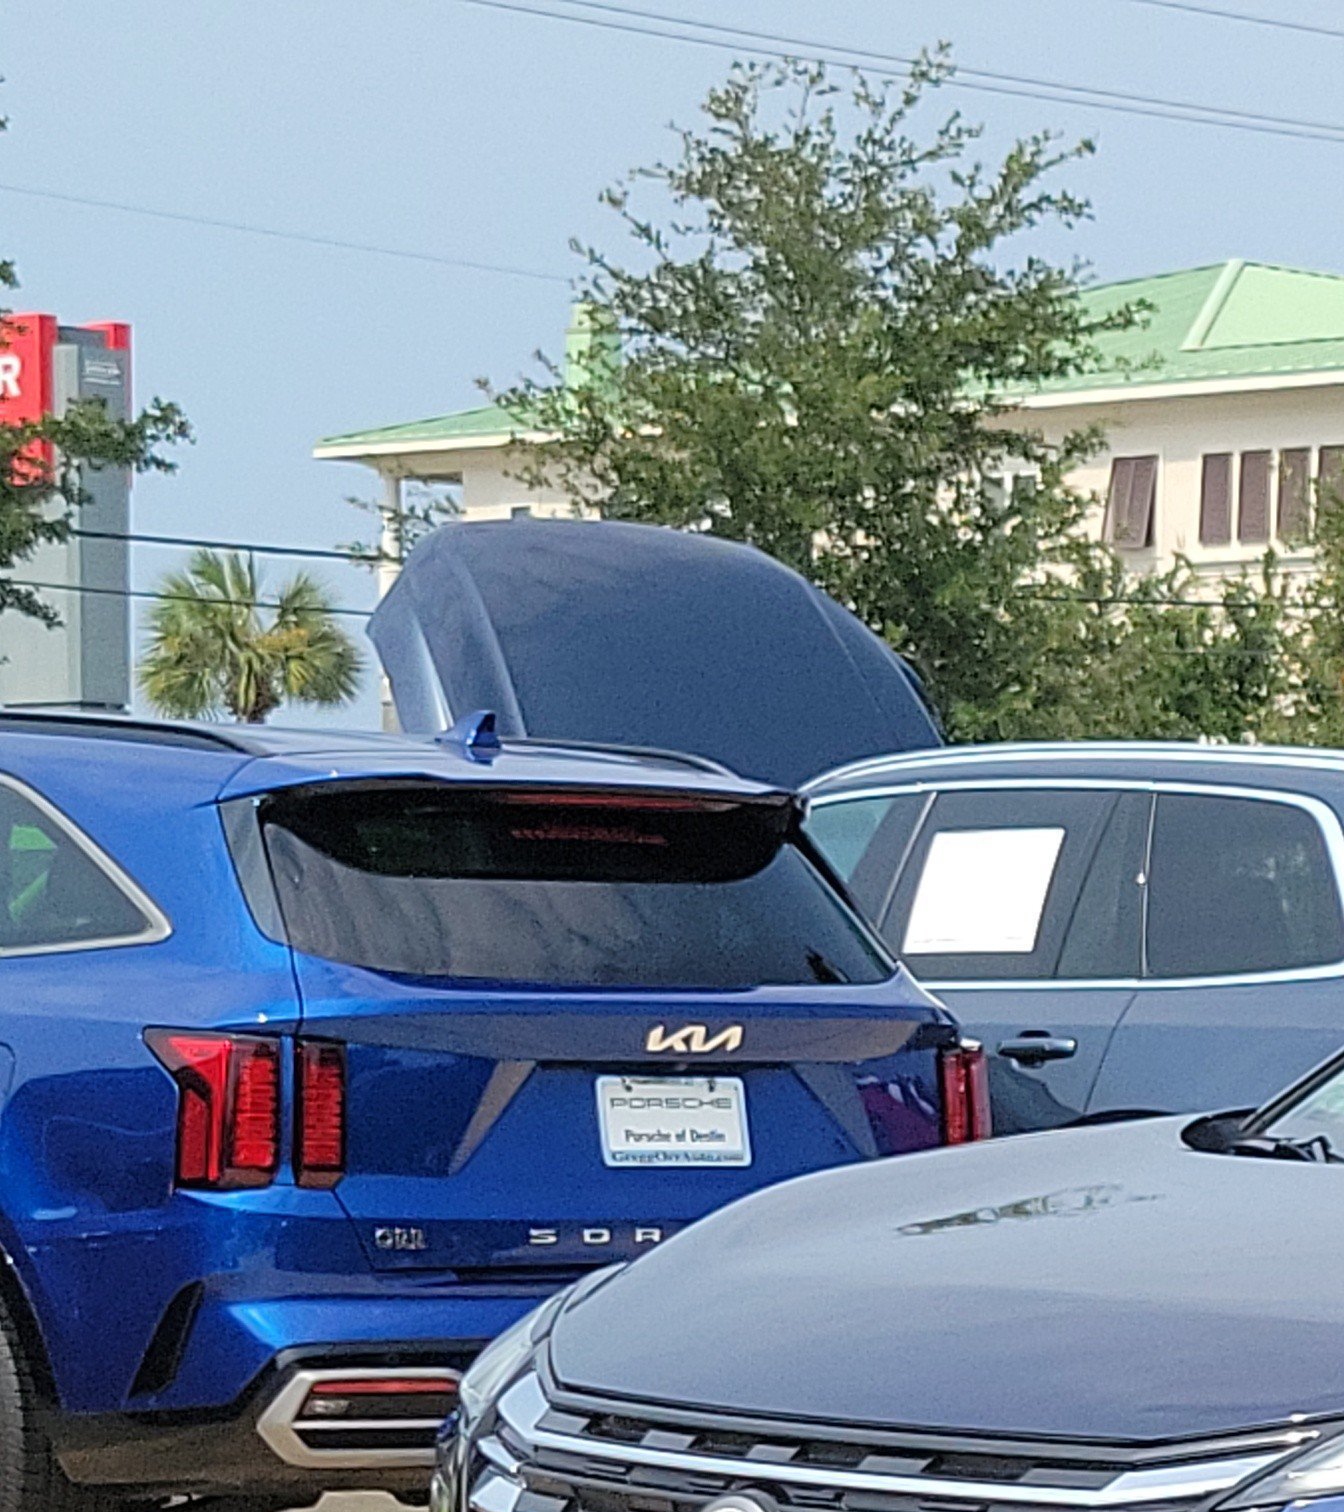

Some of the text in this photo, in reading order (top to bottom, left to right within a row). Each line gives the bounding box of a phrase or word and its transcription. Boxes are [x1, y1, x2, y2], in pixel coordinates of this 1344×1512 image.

[646, 1024, 743, 1053] KIA
[609, 1097, 732, 1109] PORSCHE
[624, 1128, 672, 1143] Porsche
[690, 1128, 726, 1142] Destin
